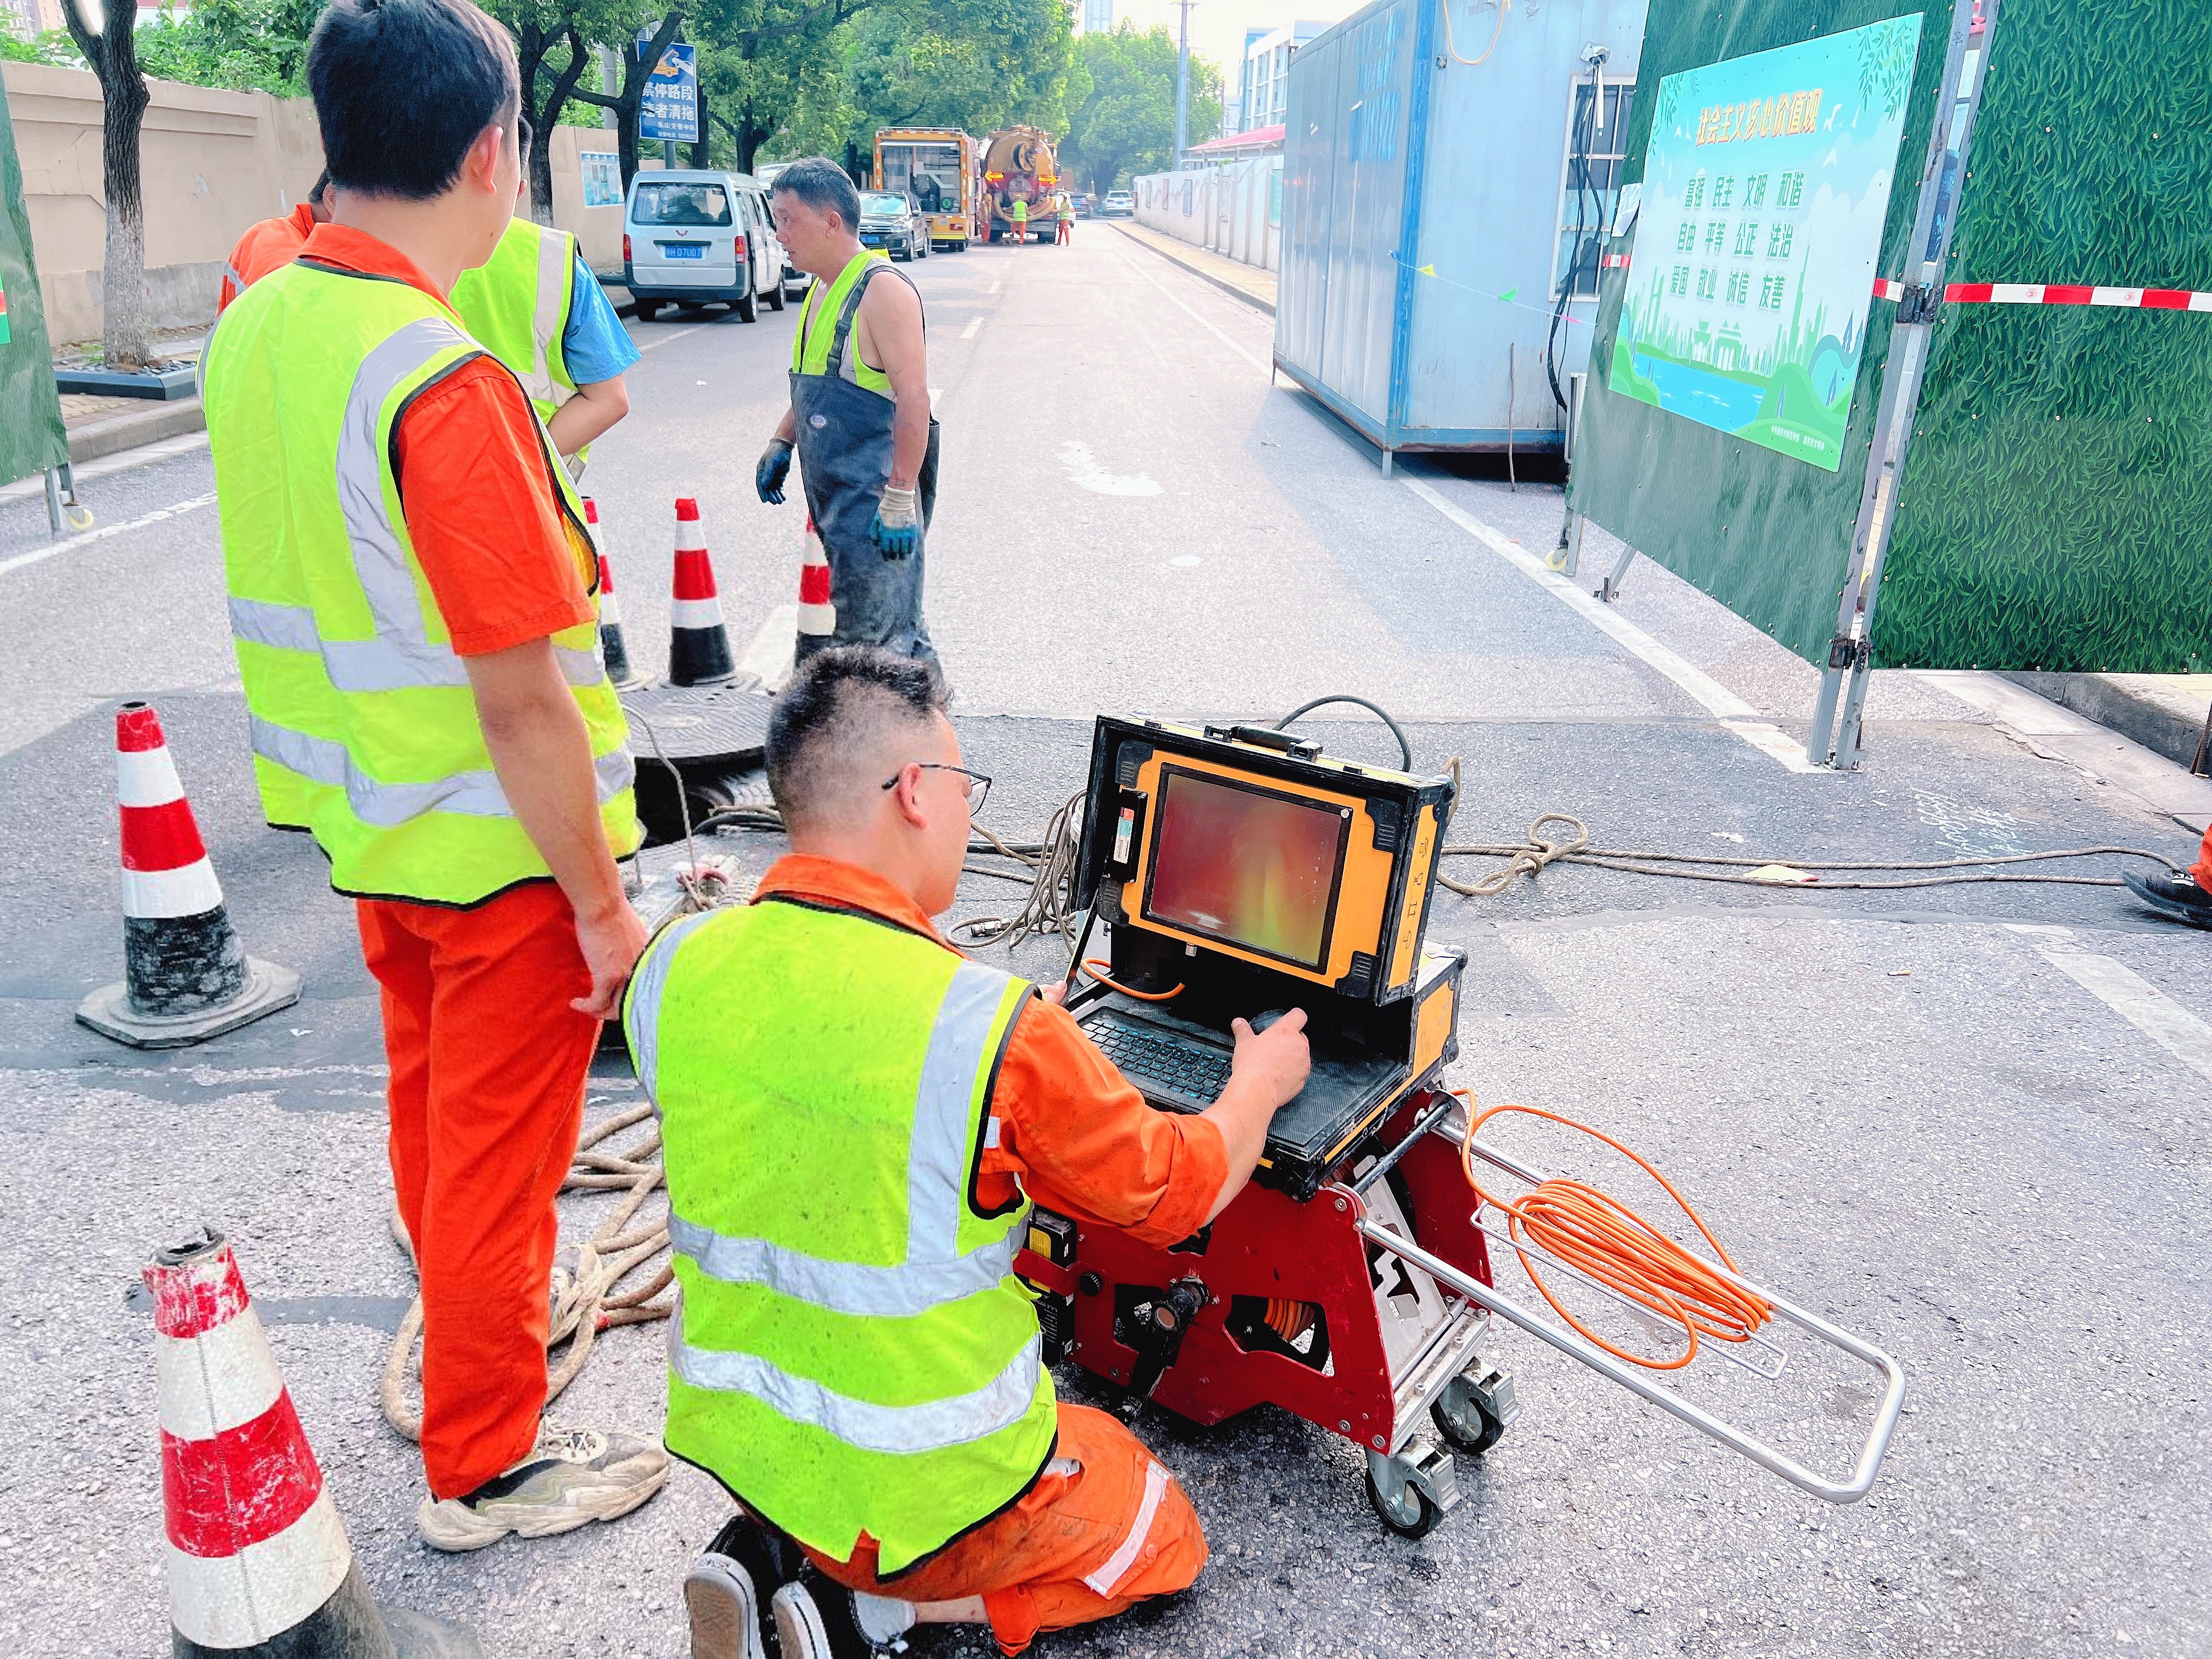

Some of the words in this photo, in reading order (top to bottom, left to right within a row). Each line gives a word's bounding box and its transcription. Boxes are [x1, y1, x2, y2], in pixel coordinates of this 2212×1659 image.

[642, 81, 694, 101] 禁停路段
[1696, 88, 1822, 146] 社会主义核心价值观
[1685, 177, 1705, 207] 富强
[1713, 176, 1734, 207] 民主
[1743, 173, 1768, 207] 文明
[1777, 171, 1805, 207] 和谐
[1677, 221, 1696, 251] 自由
[1705, 222, 1726, 253] 平等
[1734, 222, 1758, 256] 公正
[1767, 223, 1795, 258] 法治
[1669, 265, 1689, 295] 爱国
[1697, 267, 1717, 300] 敬业
[1726, 270, 1750, 304] 诚信
[1759, 274, 1785, 309] 友善
